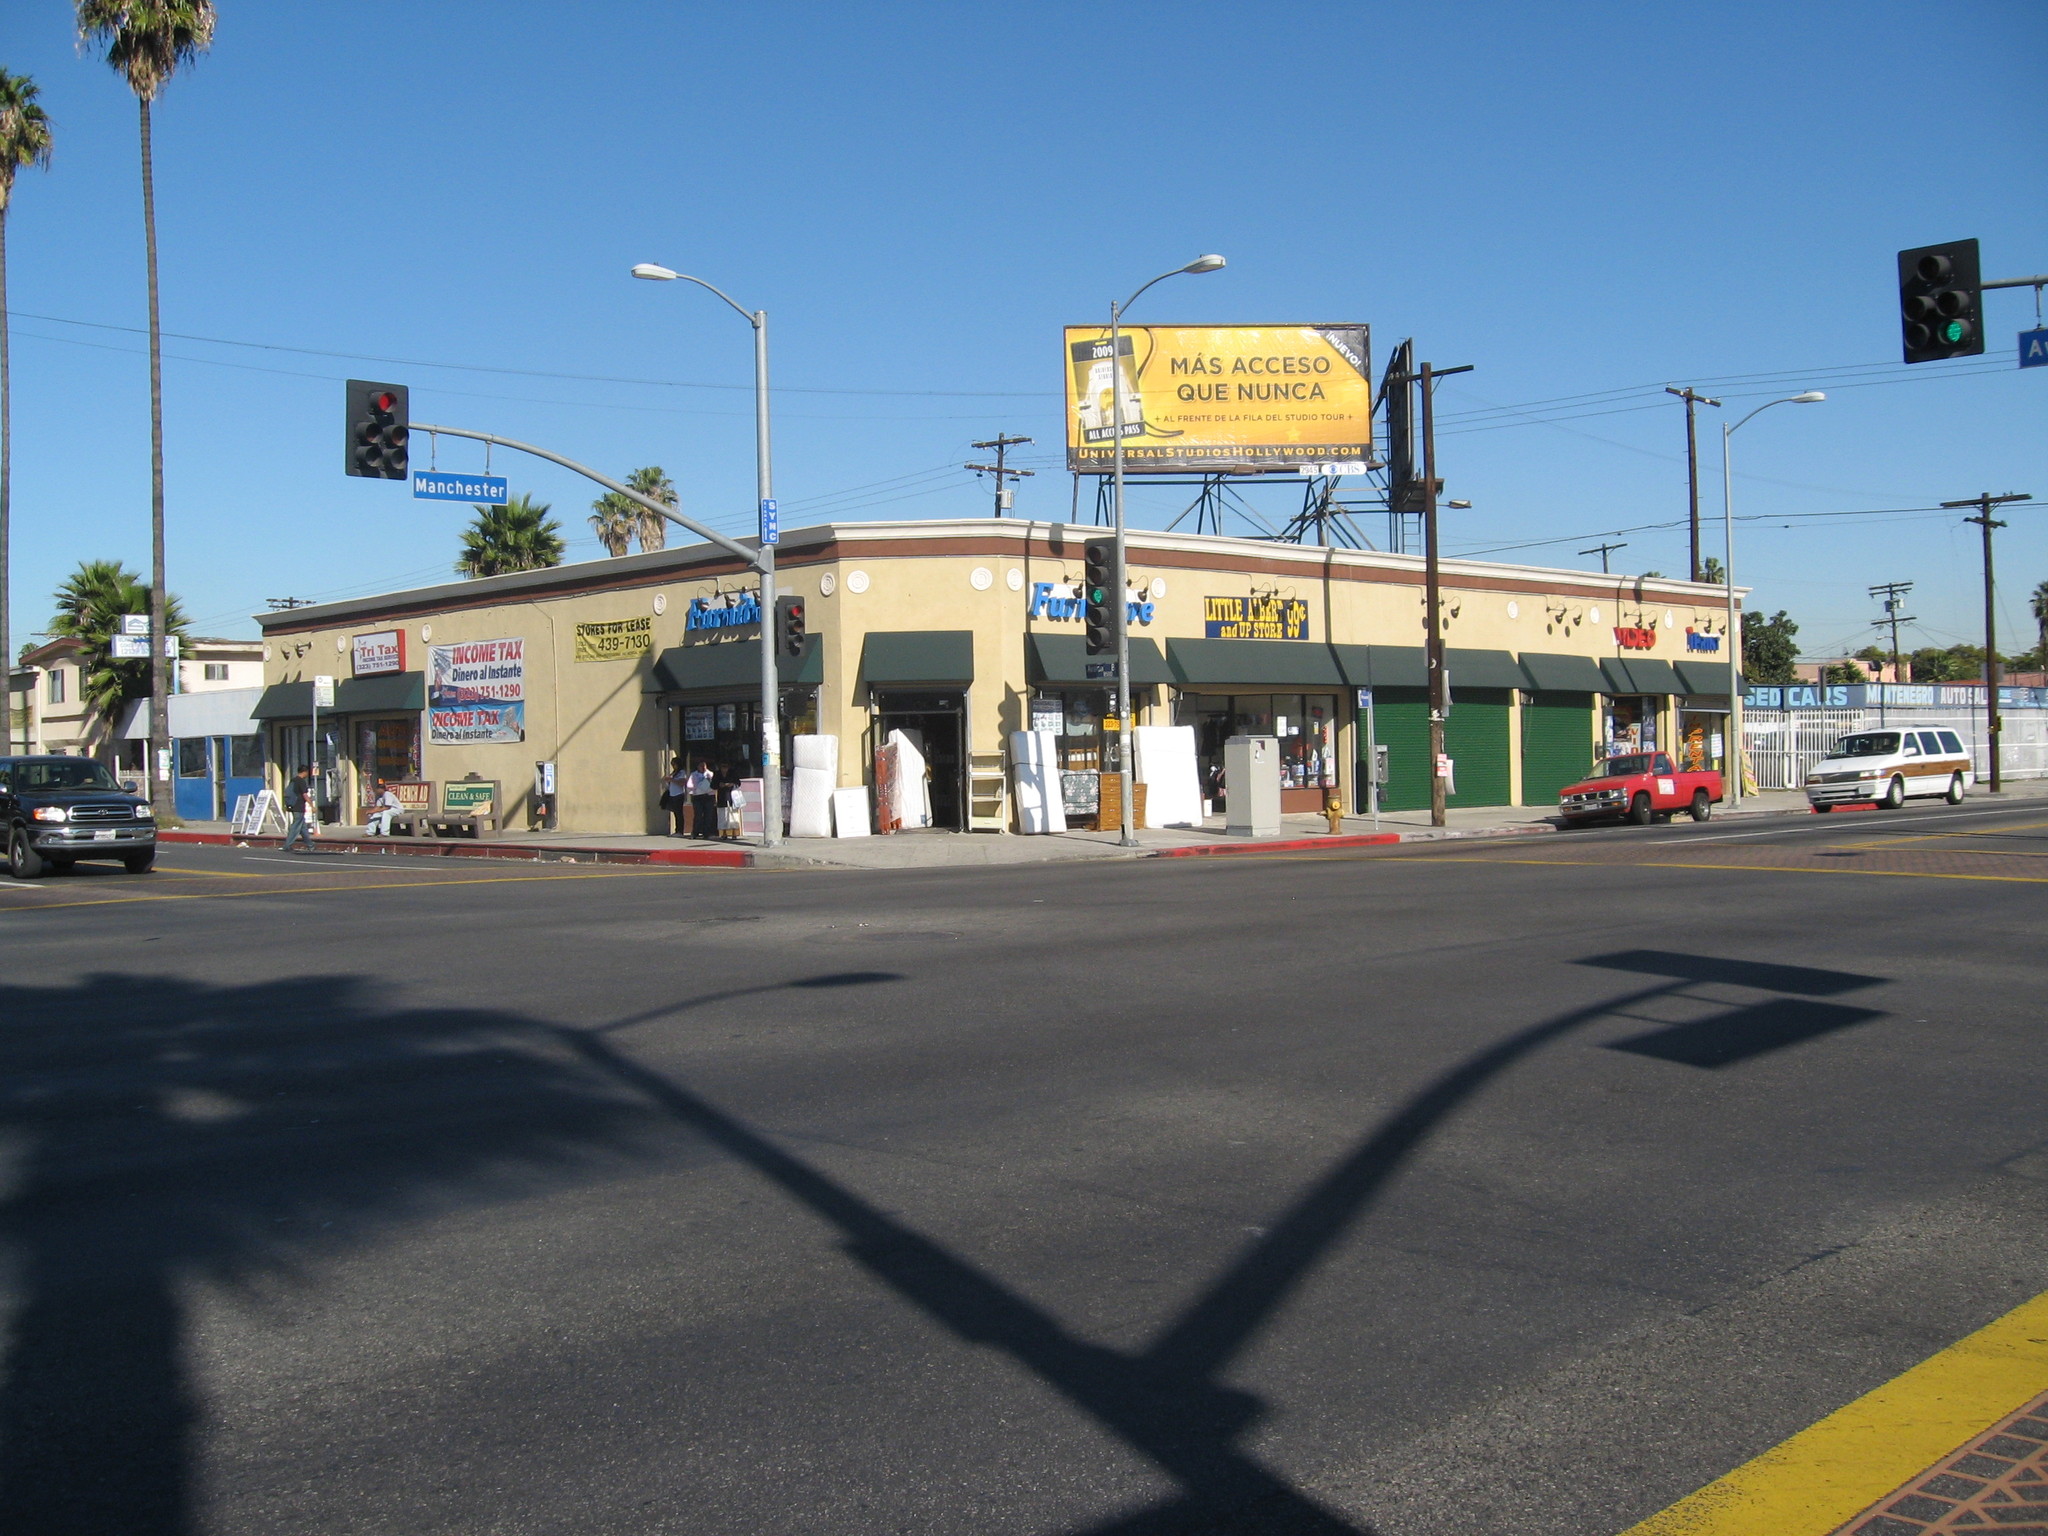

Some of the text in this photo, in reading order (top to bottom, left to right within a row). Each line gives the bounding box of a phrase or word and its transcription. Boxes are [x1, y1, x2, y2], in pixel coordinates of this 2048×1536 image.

[1092, 345, 1113, 359] 2009
[1170, 352, 1331, 375] MÁS ACCESO
[1177, 382, 1326, 402] QUE NUNCA
[1164, 413, 1345, 423] AL FRENTE DE LA FILA DEL STUDIO TOUR
[1088, 429, 1101, 440] ALL
[1124, 424, 1140, 435] PASS
[1339, 464, 1360, 474] CBS
[415, 477, 505, 498] Manchester
[1204, 598, 1243, 621] LITTLE
[576, 617, 651, 637] STORES FOR LEASE
[1220, 621, 1283, 638] and UP STORE
[598, 634, 651, 651] 439-7130
[1613, 627, 1656, 648] VIDEO
[360, 644, 398, 657] Tri Tax
[452, 641, 523, 665] INCOME TAX
[452, 663, 522, 682] Dinero al Instante
[480, 684, 521, 699] 751-1290
[1940, 687, 1966, 705] AUTO
[432, 710, 499, 727] INCOME TAX
[431, 729, 454, 740] Dinero
[462, 729, 493, 739] Instante
[419, 784, 429, 801] AD
[448, 792, 491, 800] CLEAN & SAFE
